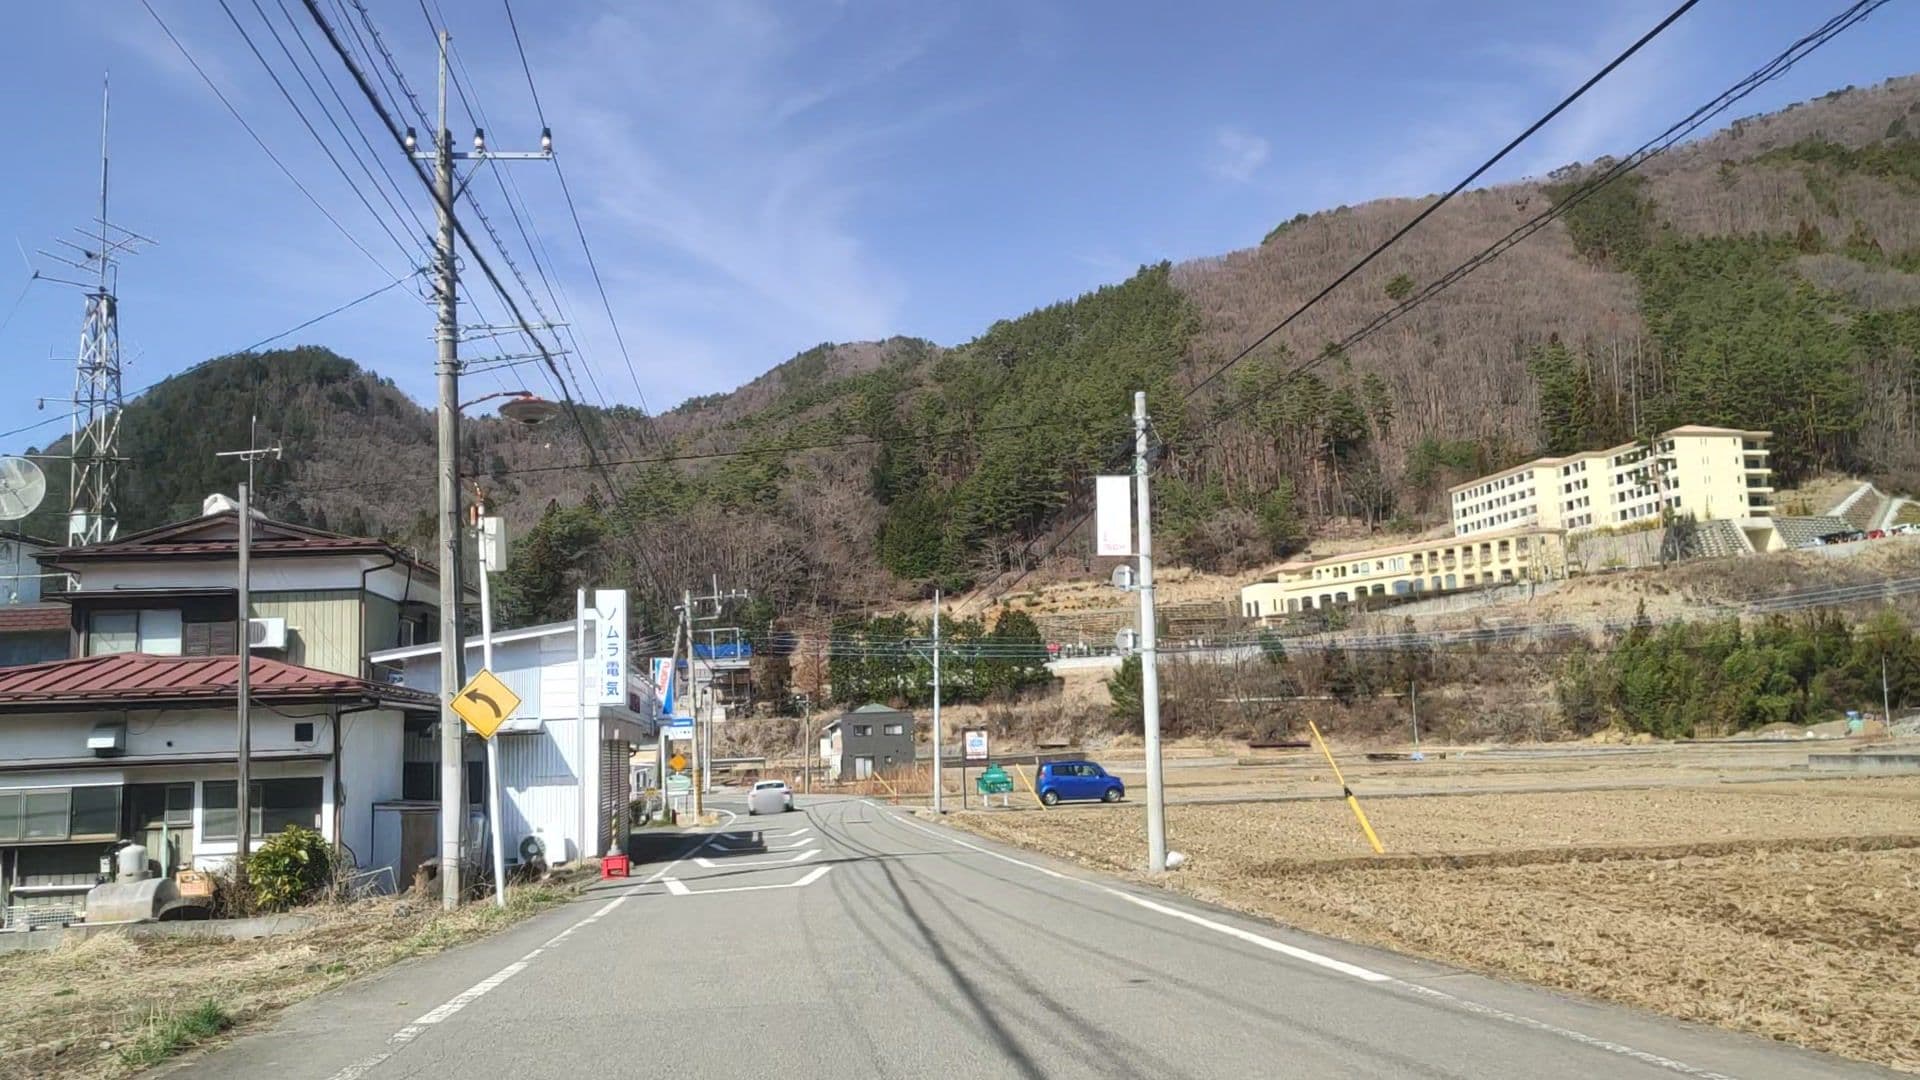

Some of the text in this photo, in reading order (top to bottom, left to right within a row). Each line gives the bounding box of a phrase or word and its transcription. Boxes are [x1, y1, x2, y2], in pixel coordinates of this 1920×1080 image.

[606, 607, 620, 697] ノムラ電気
